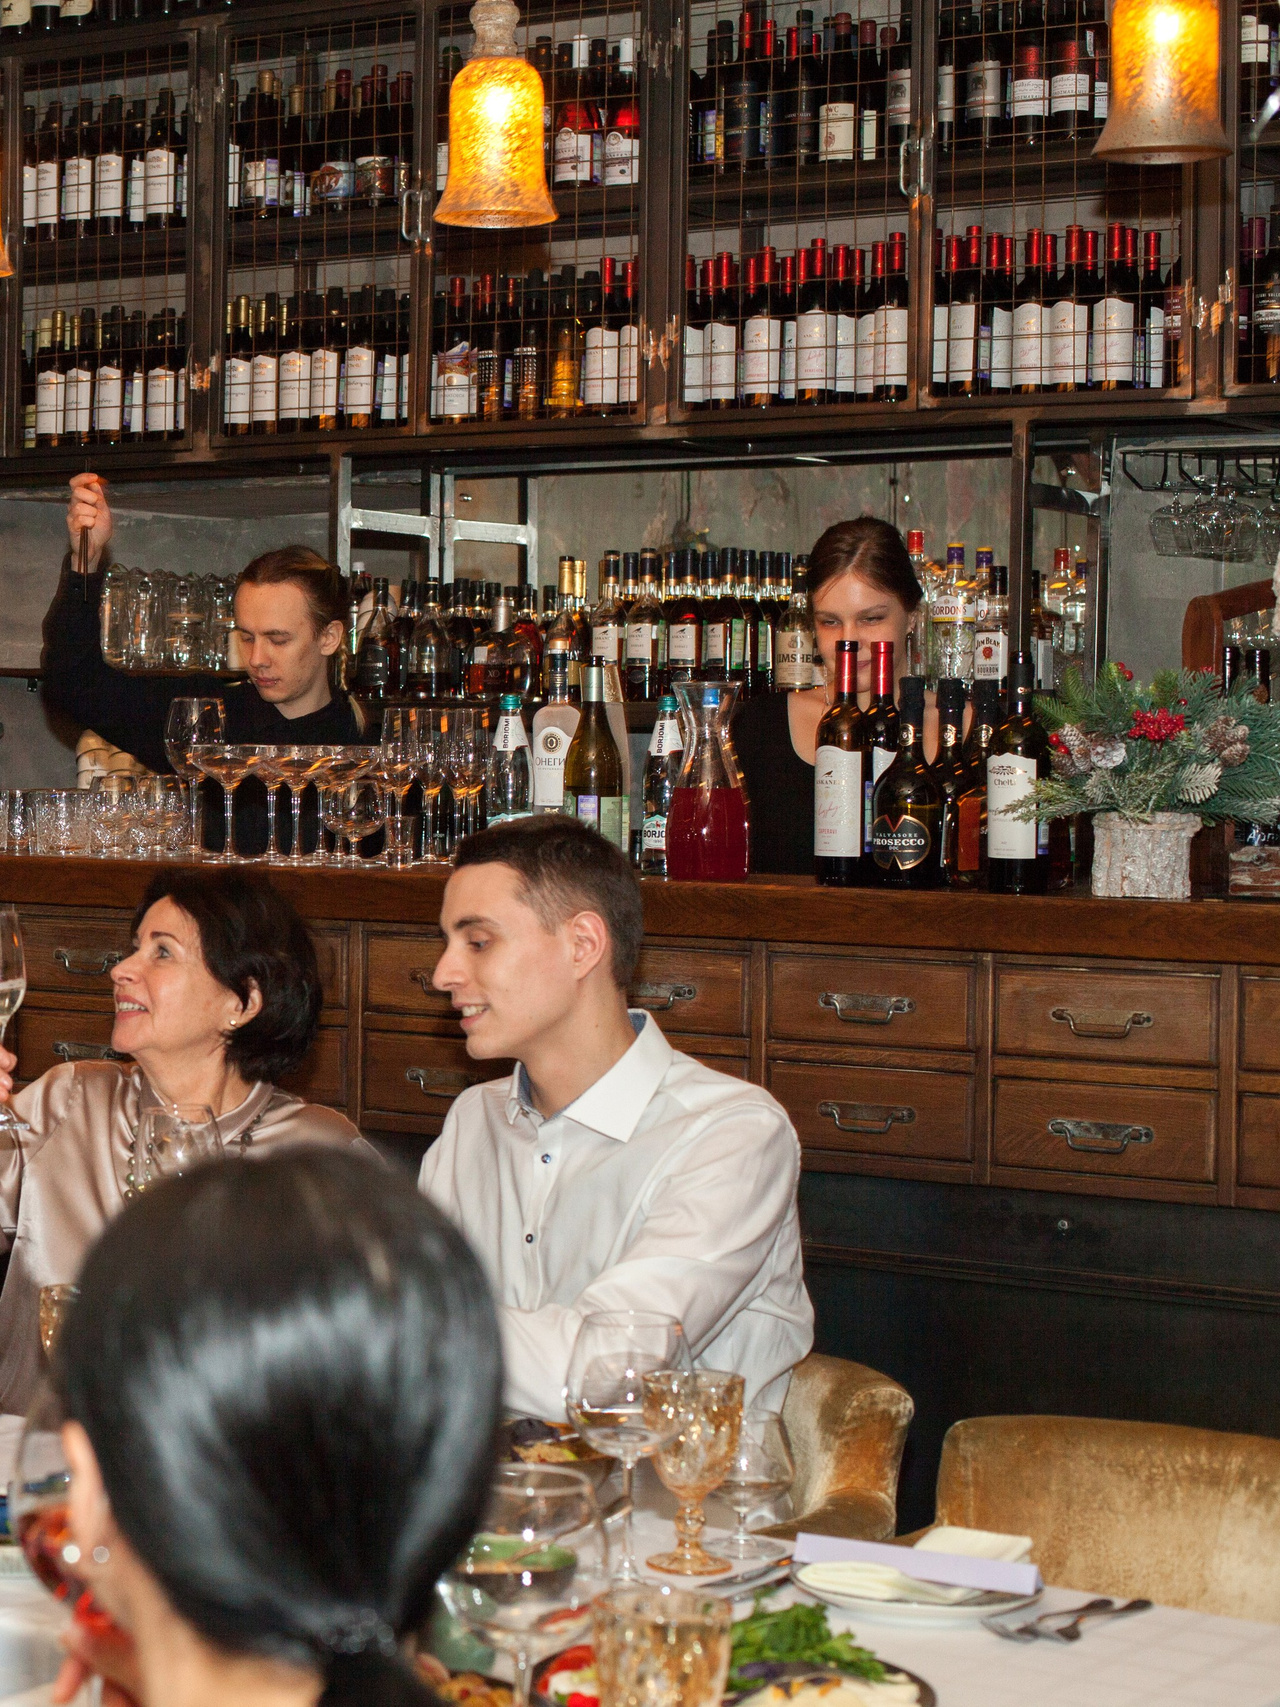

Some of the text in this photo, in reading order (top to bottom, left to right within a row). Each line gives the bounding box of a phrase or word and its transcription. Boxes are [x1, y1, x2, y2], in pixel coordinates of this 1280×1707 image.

[487, 669, 500, 678] XO
[502, 718, 510, 749] BORJOMI
[656, 722, 664, 754] BORJOMI
[873, 838, 926, 847] PROSECCO
